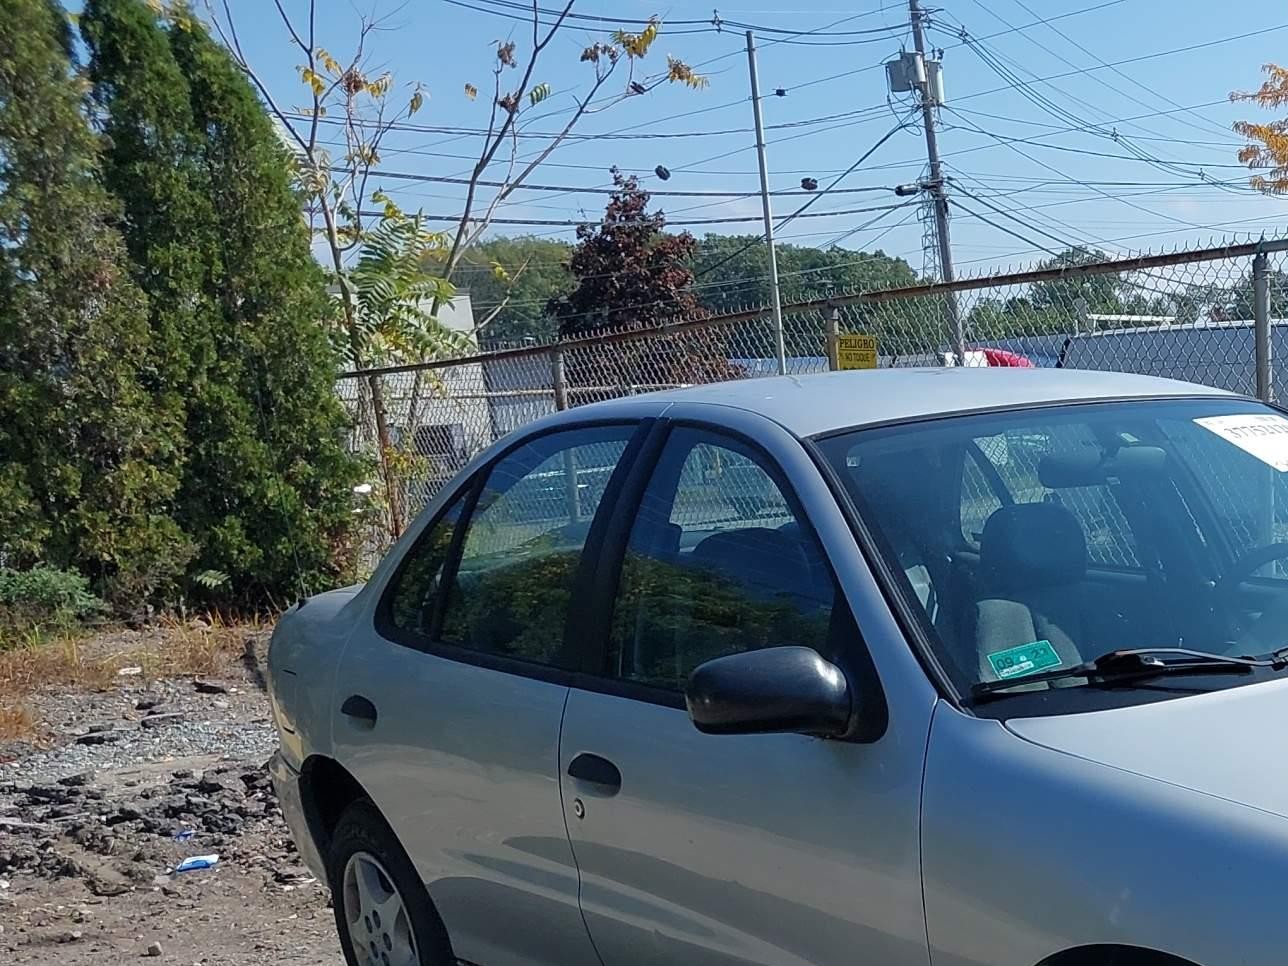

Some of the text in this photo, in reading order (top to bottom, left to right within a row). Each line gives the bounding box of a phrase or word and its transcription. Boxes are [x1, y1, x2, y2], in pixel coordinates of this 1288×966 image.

[839, 338, 875, 349] PELIGRO
[845, 352, 853, 362] NO
[996, 656, 1015, 671] 09
